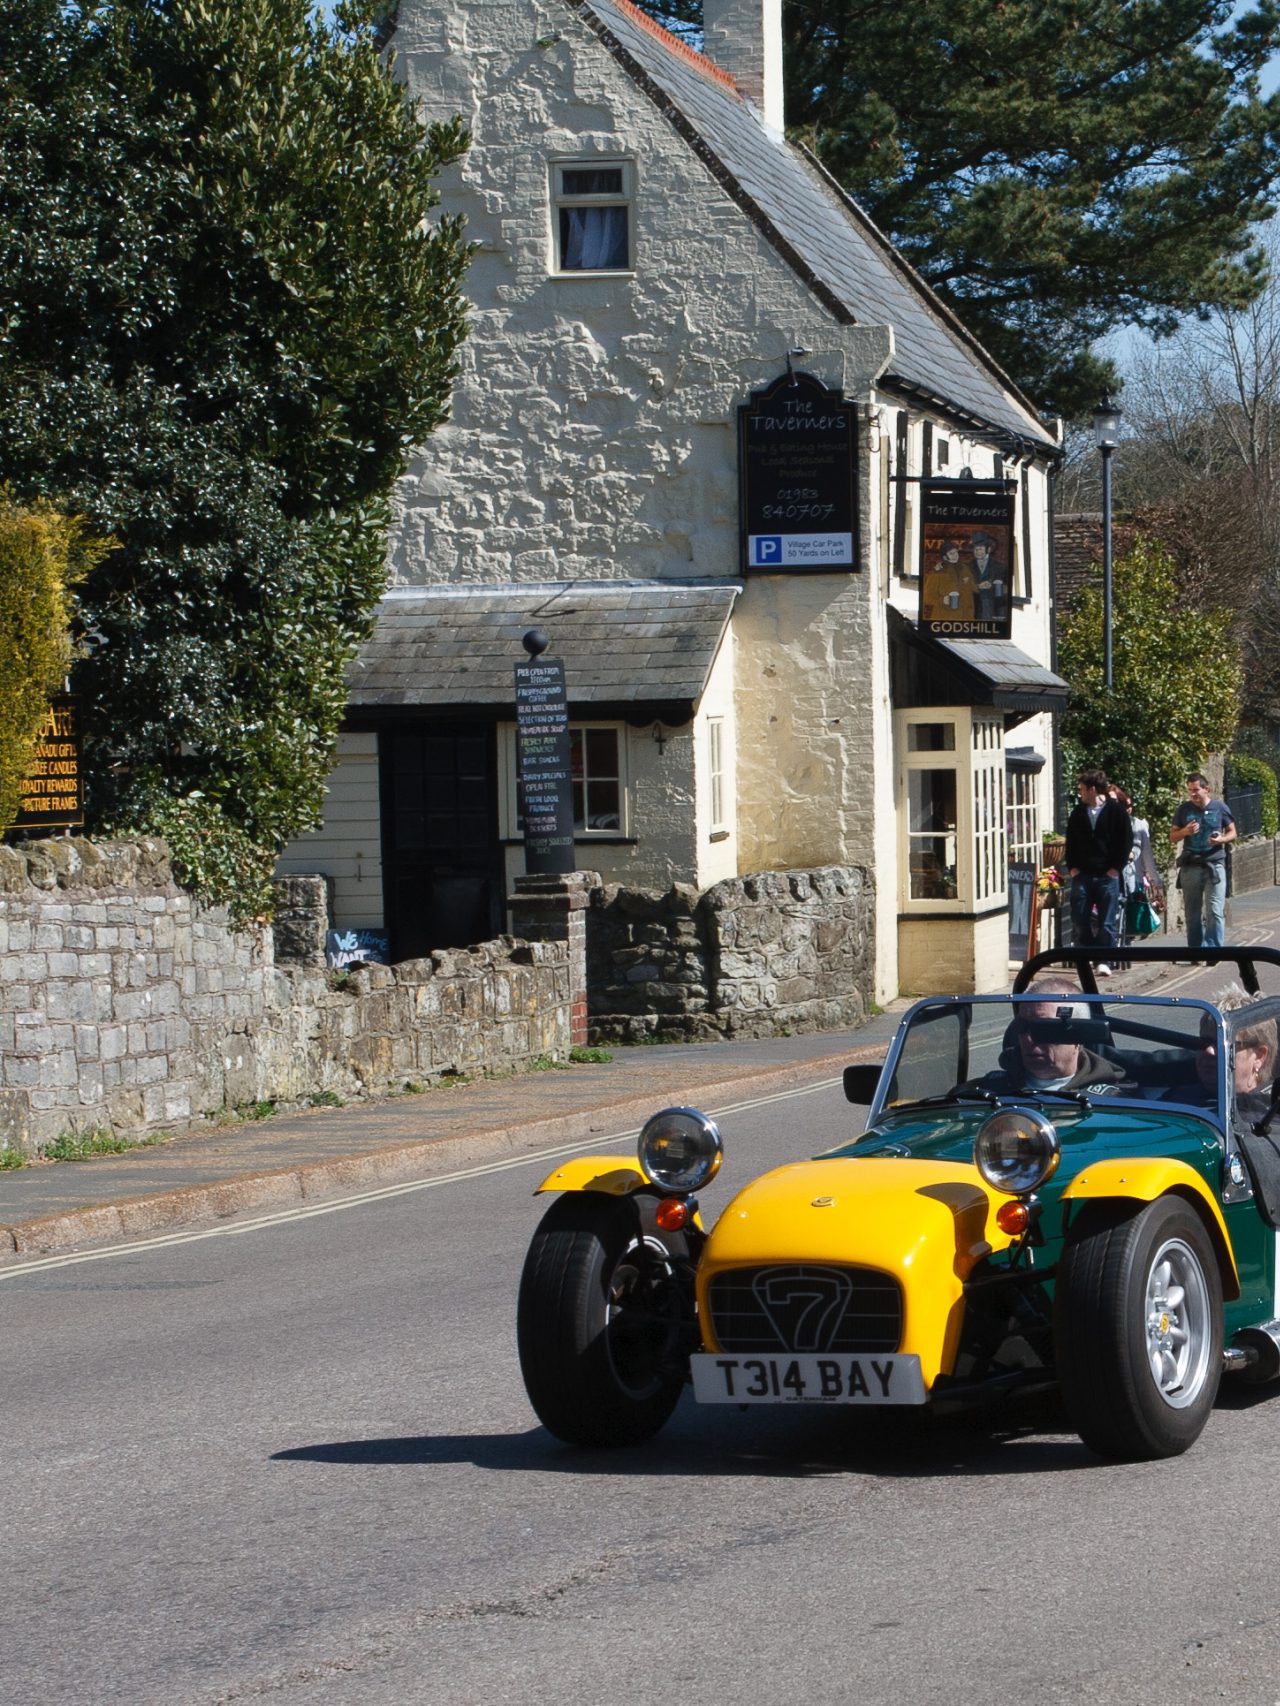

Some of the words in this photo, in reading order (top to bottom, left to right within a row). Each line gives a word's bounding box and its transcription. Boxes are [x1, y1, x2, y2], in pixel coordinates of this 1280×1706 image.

[784, 400, 813, 413] The
[750, 415, 846, 430] Taverners
[777, 488, 819, 503] 01983
[762, 504, 835, 520] 840707
[927, 505, 948, 516] The
[951, 505, 1008, 517] Taverners
[761, 541, 776, 559] P
[787, 541, 811, 549] Village
[930, 622, 999, 633] GODSHILL
[49, 760, 77, 774] CANDLES
[47, 779, 77, 792] REWARDS
[52, 797, 77, 810] FRAMES
[334, 931, 358, 950] WE
[766, 1276, 840, 1350] 7
[716, 1360, 806, 1397] T314
[817, 1360, 894, 1397] BAY
